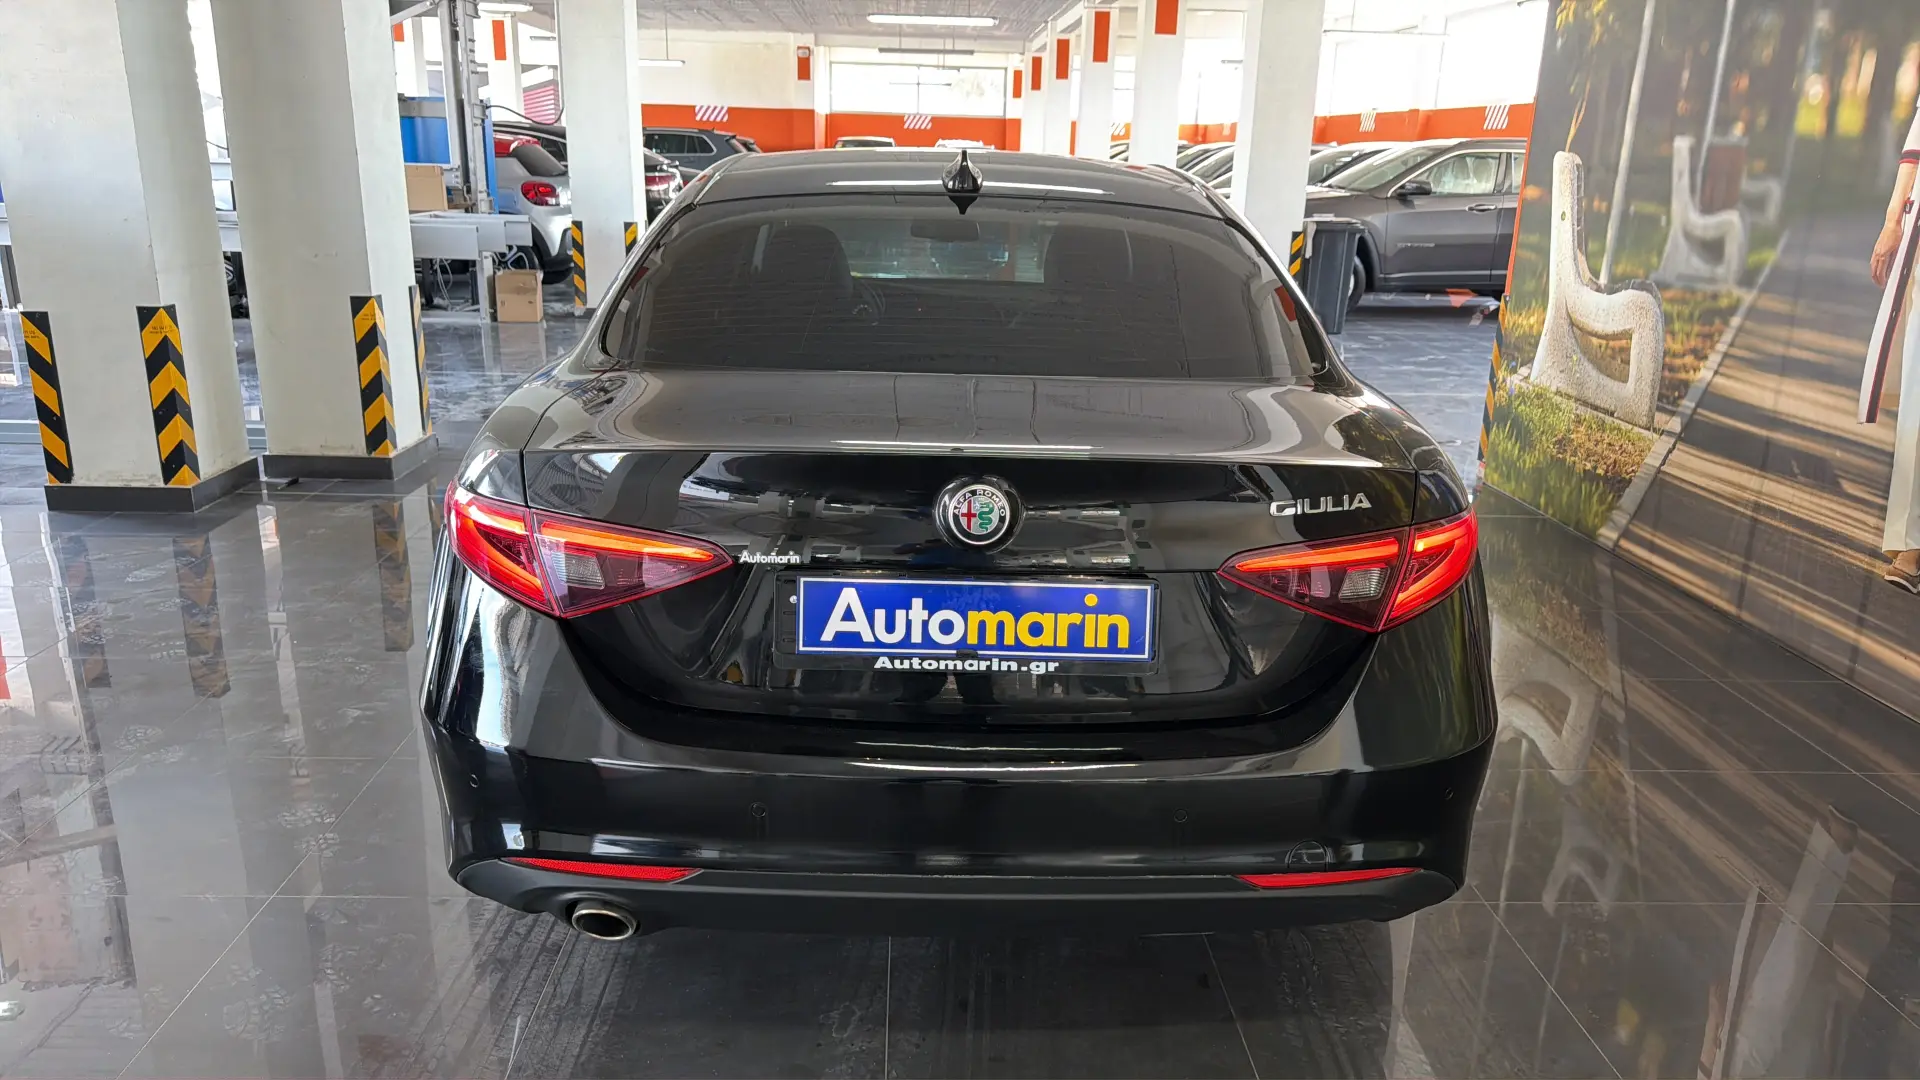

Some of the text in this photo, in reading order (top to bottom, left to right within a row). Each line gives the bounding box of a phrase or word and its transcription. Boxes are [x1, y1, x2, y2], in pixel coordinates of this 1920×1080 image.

[953, 489, 1006, 517] ALFA ROMEO
[1269, 492, 1372, 517] GIULIA
[739, 550, 800, 564] Automarin
[819, 586, 1130, 649] Automarin
[873, 656, 1060, 675] Automarin.gr
